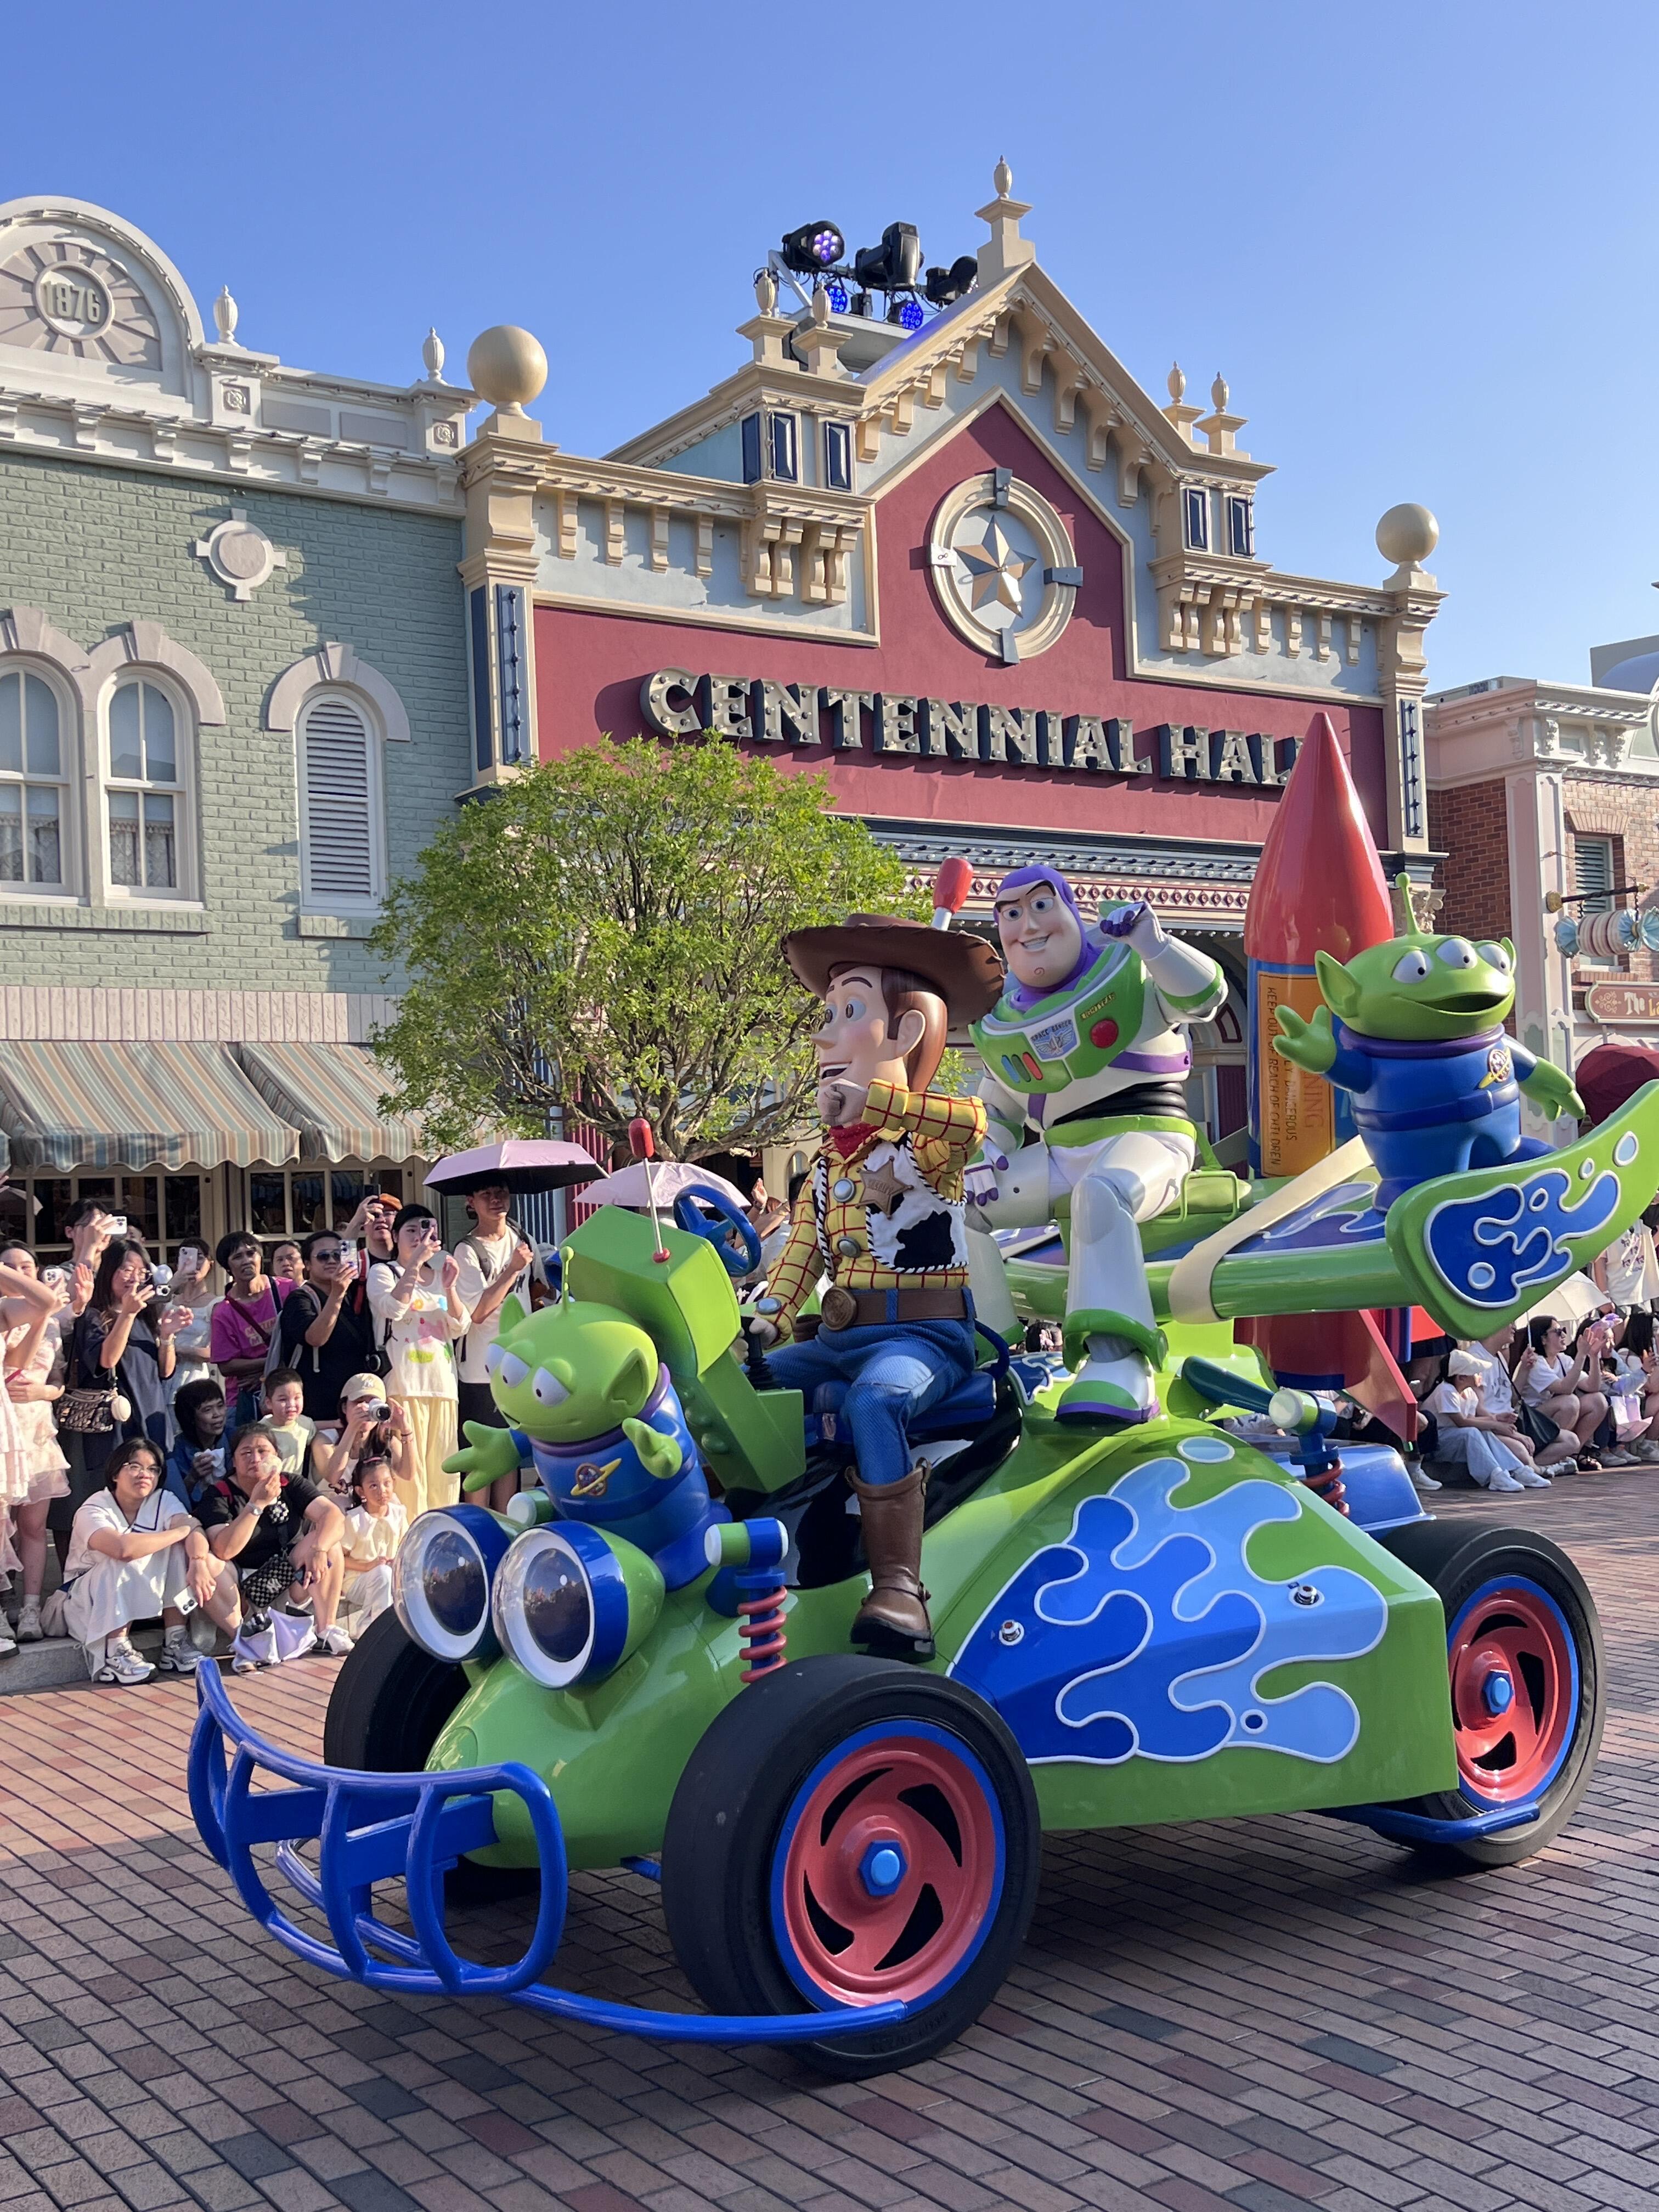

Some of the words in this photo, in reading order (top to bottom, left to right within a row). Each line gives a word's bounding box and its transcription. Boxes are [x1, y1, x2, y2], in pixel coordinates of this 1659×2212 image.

[43, 281, 100, 323] 1876
[640, 666, 1153, 775] CENTENNIAL
[1267, 987, 1278, 1013] KEEP
[1624, 991, 1645, 1015] The
[1030, 1029, 1049, 1042] SPACE
[1267, 1018, 1278, 1037] OUT
[1269, 1058, 1280, 1092] REACH
[1269, 1095, 1280, 1107] OF
[1301, 1071, 1324, 1128] NING
[1269, 1113, 1281, 1165] CHILDREN
